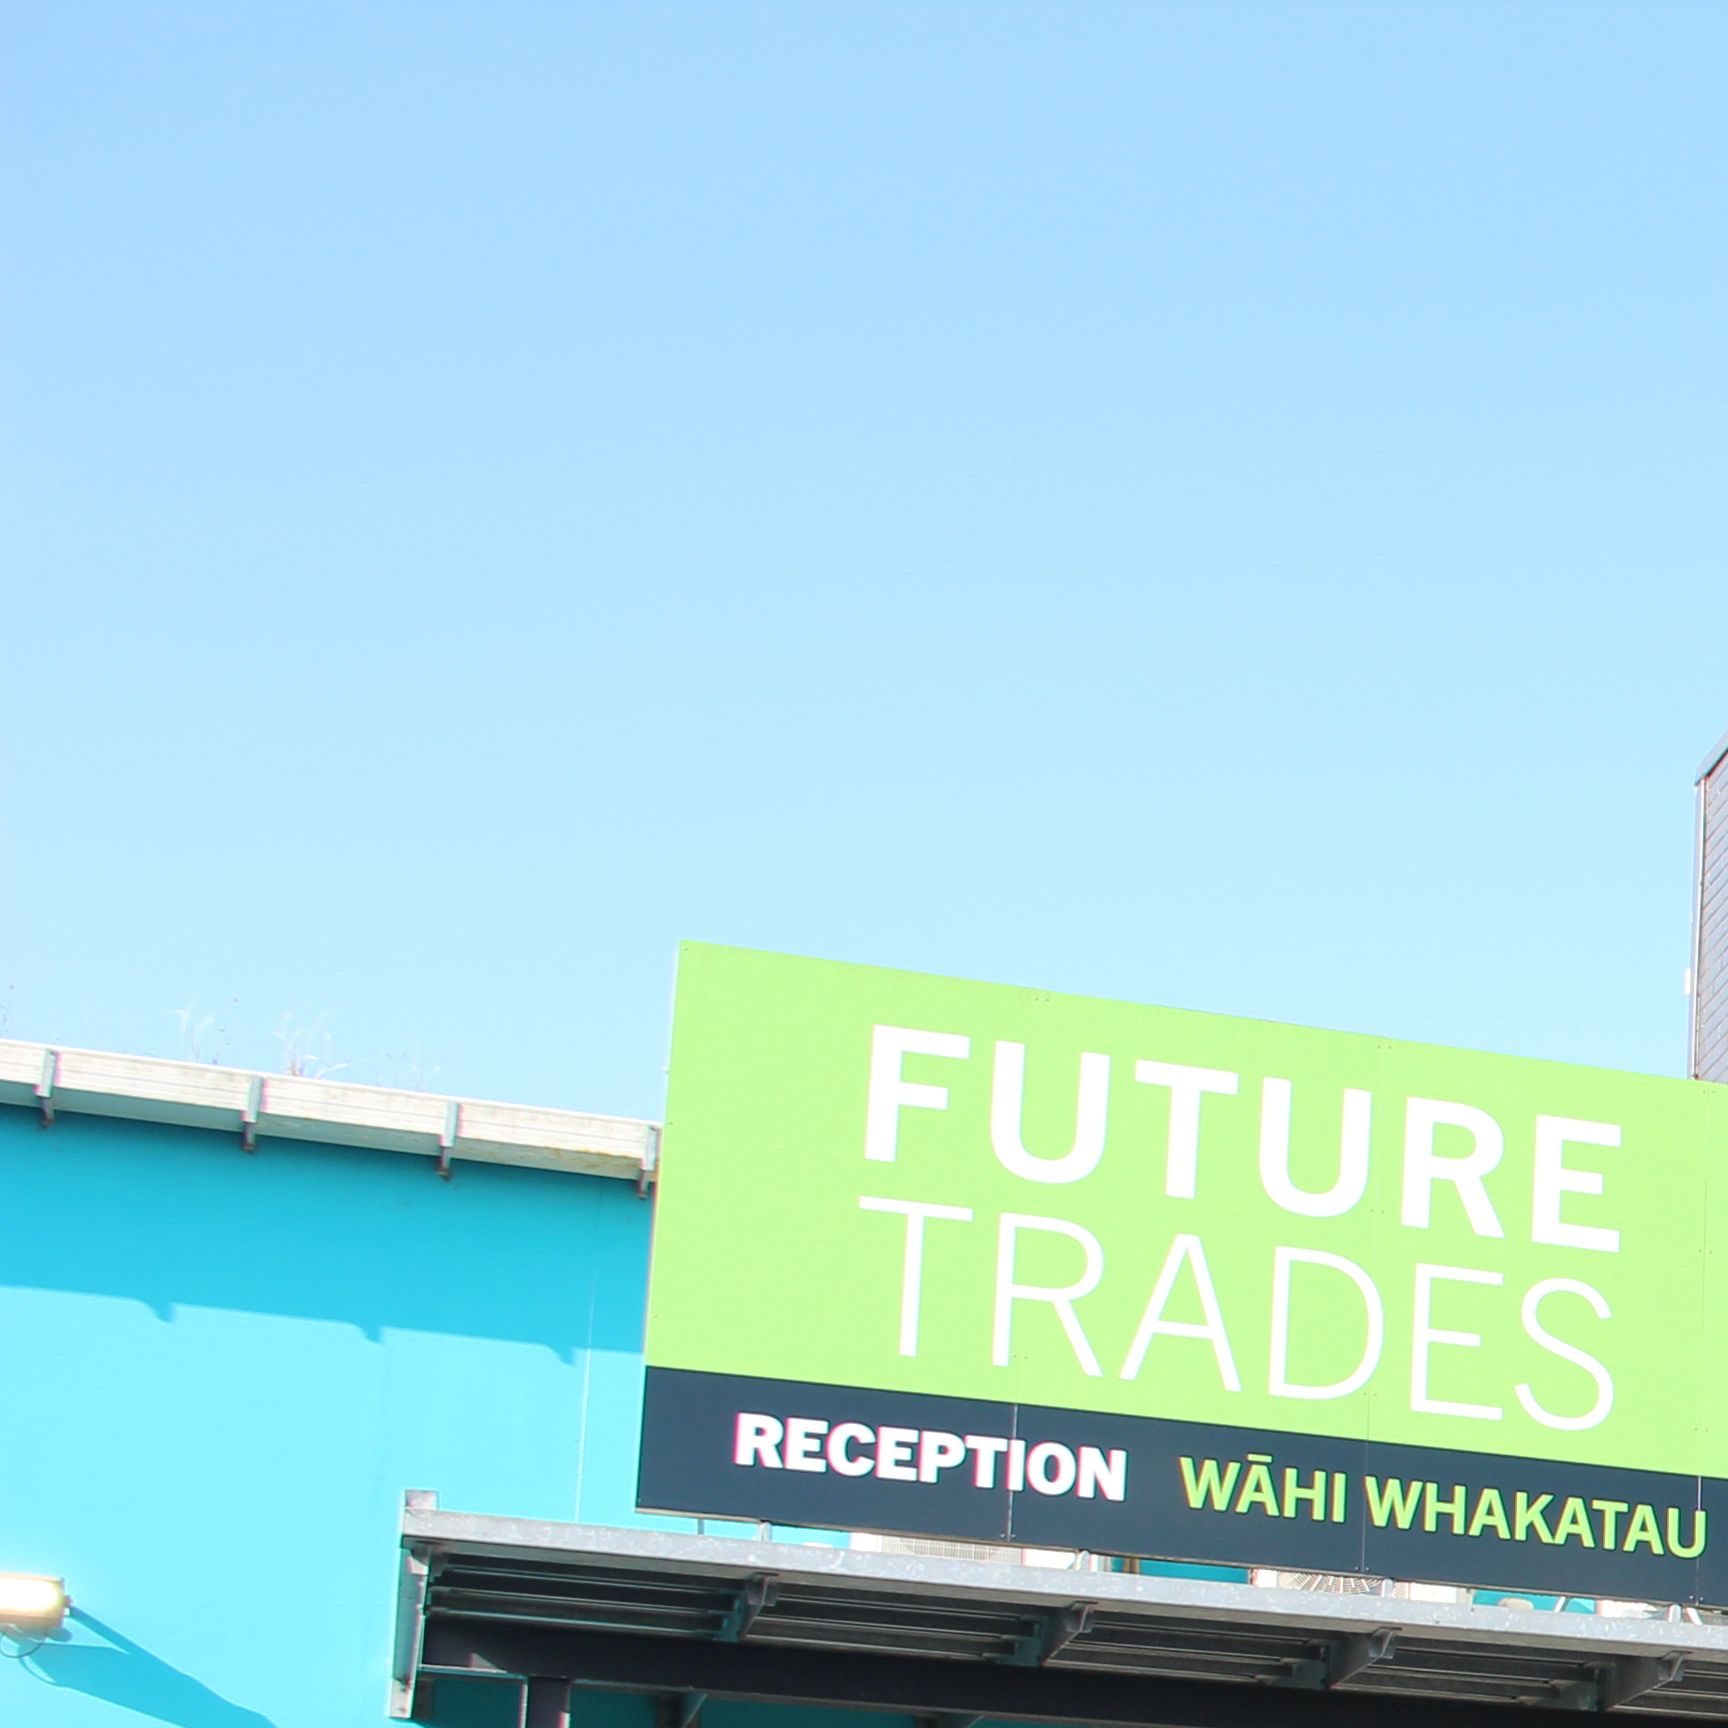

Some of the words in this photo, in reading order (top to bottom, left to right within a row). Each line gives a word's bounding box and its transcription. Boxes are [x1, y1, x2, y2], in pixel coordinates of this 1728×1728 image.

[863, 1023, 1623, 1254] FUTURE
[858, 1194, 1615, 1432] TRADES
[734, 1411, 1128, 1502] RECEPTION
[1180, 1452, 1348, 1525] WĀHI
[1365, 1473, 1709, 1560] WHAKATAU
